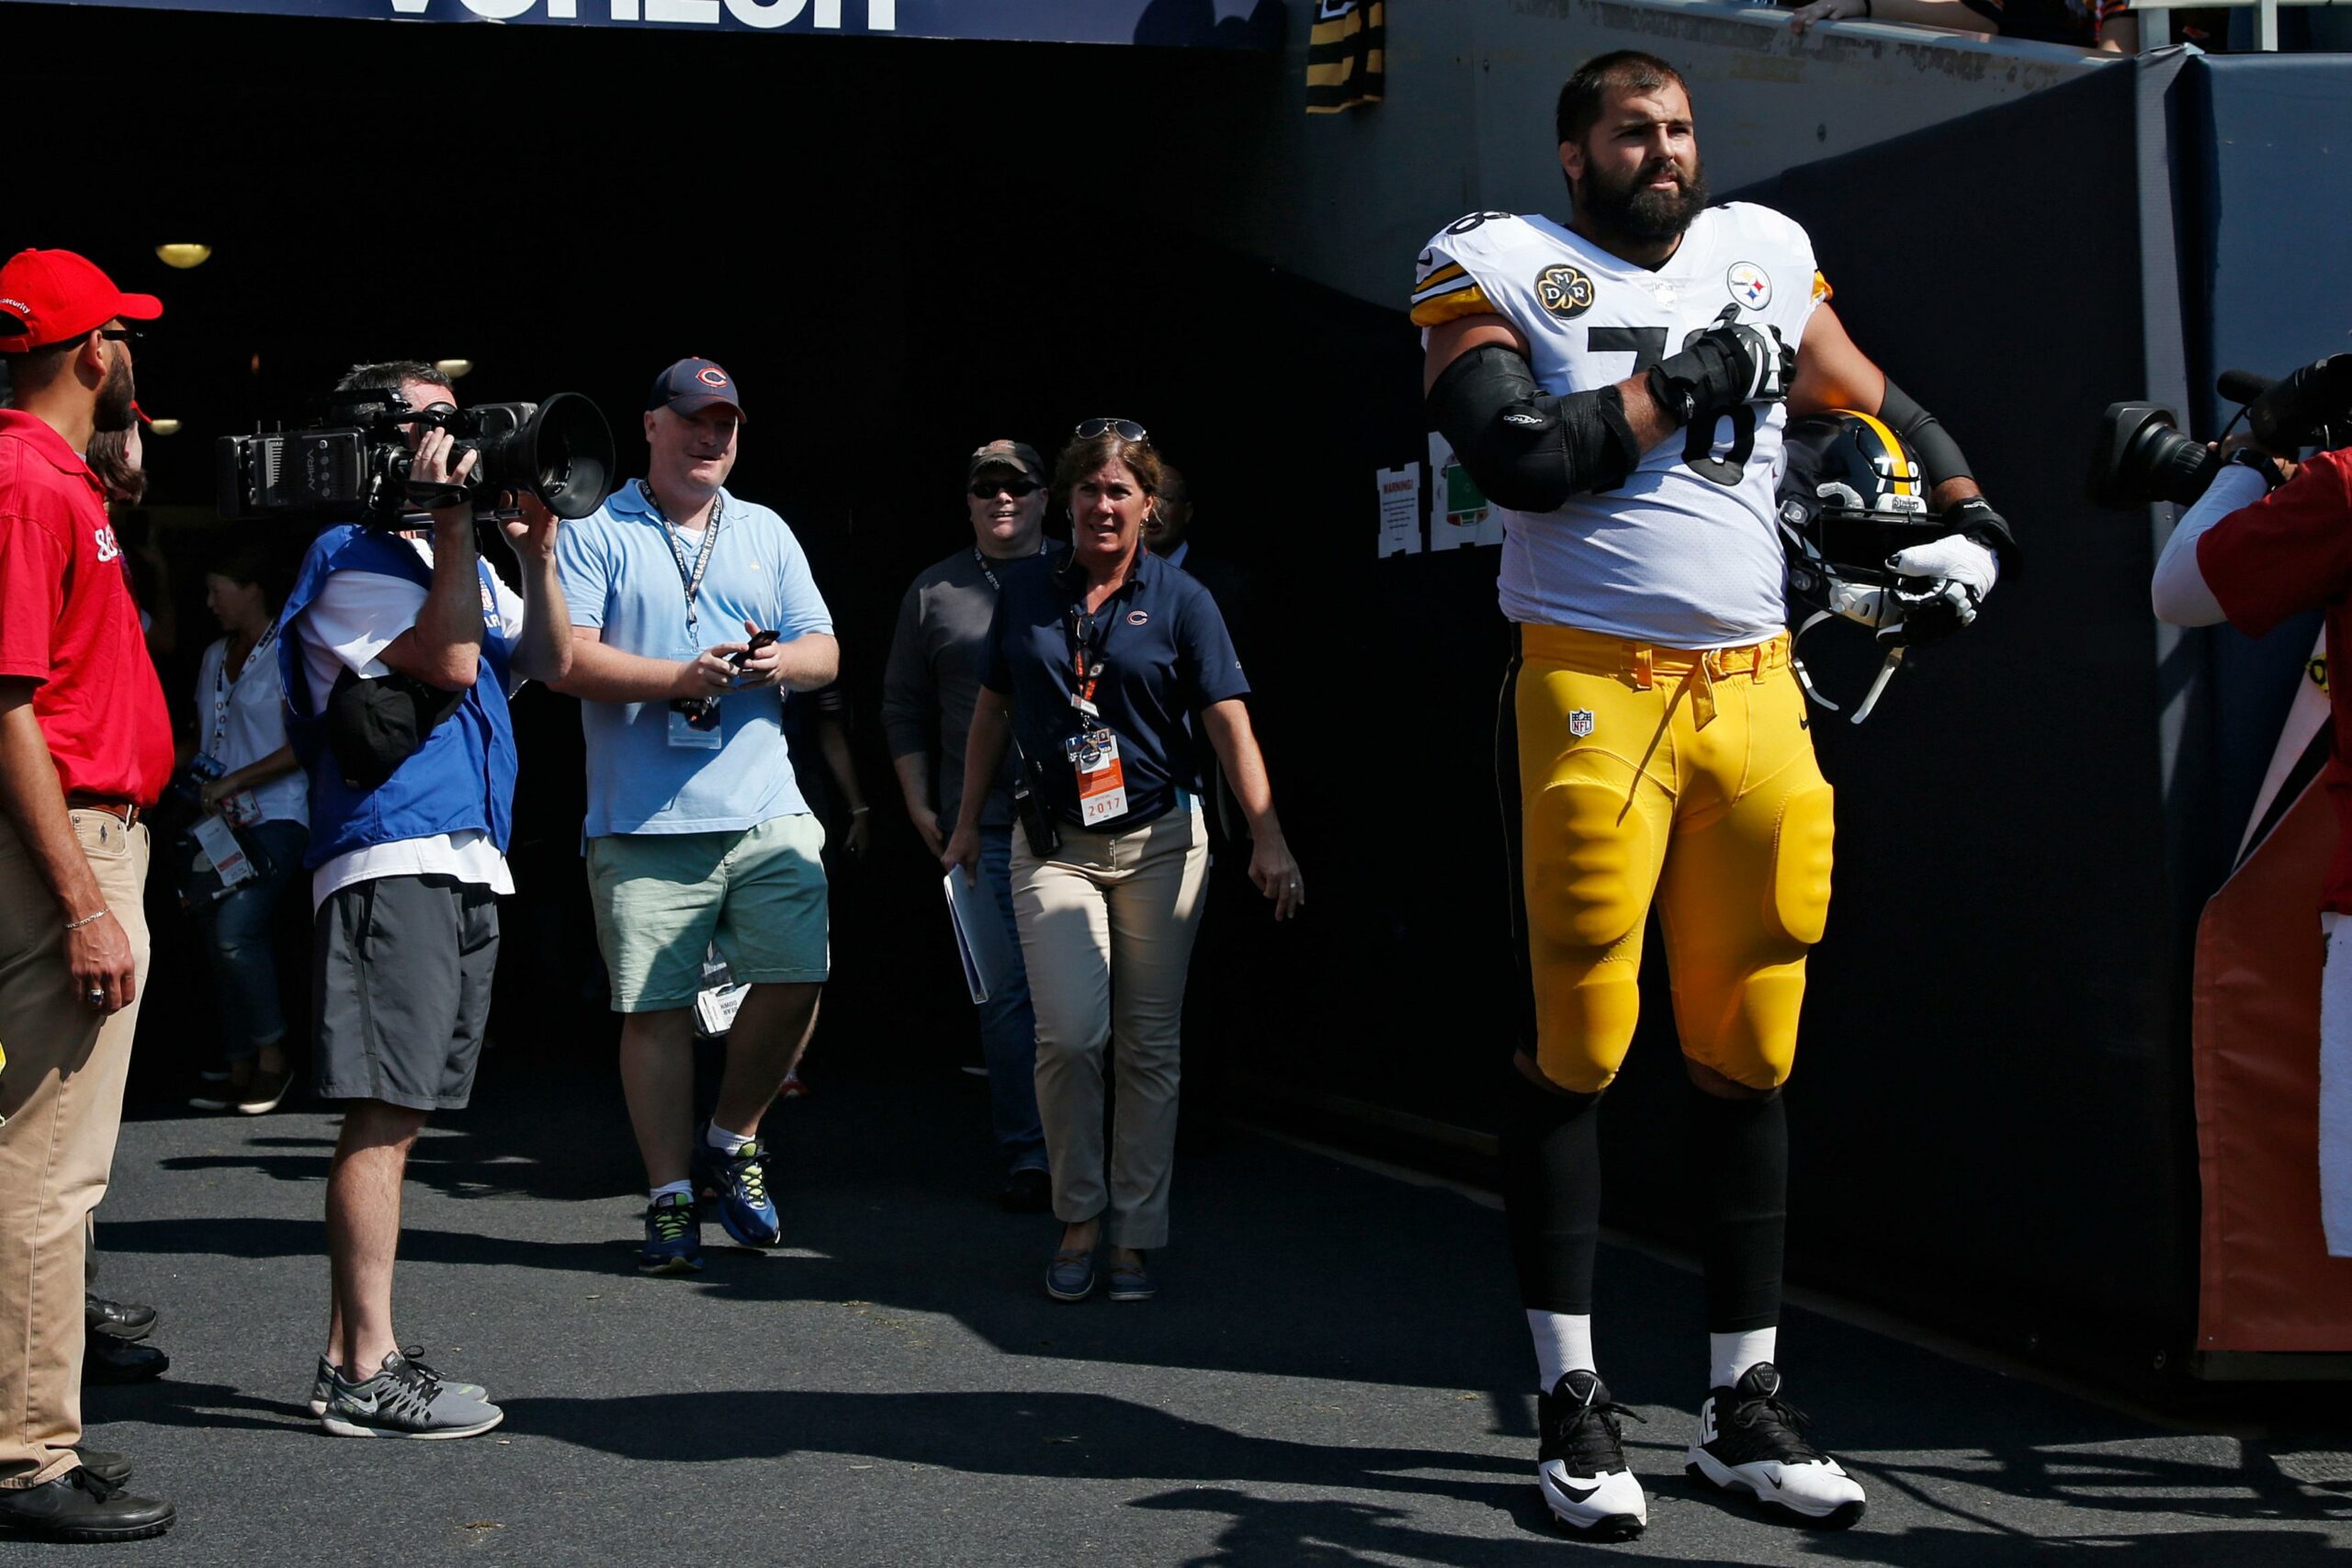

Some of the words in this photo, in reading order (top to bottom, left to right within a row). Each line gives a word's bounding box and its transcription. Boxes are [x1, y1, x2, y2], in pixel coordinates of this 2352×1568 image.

[306, 448, 316, 491] AMIRA
[693, 548, 711, 581] SEASON
[706, 520, 718, 548] TICKET
[1572, 720, 1590, 732] NFL
[1088, 796, 1121, 817] 2017
